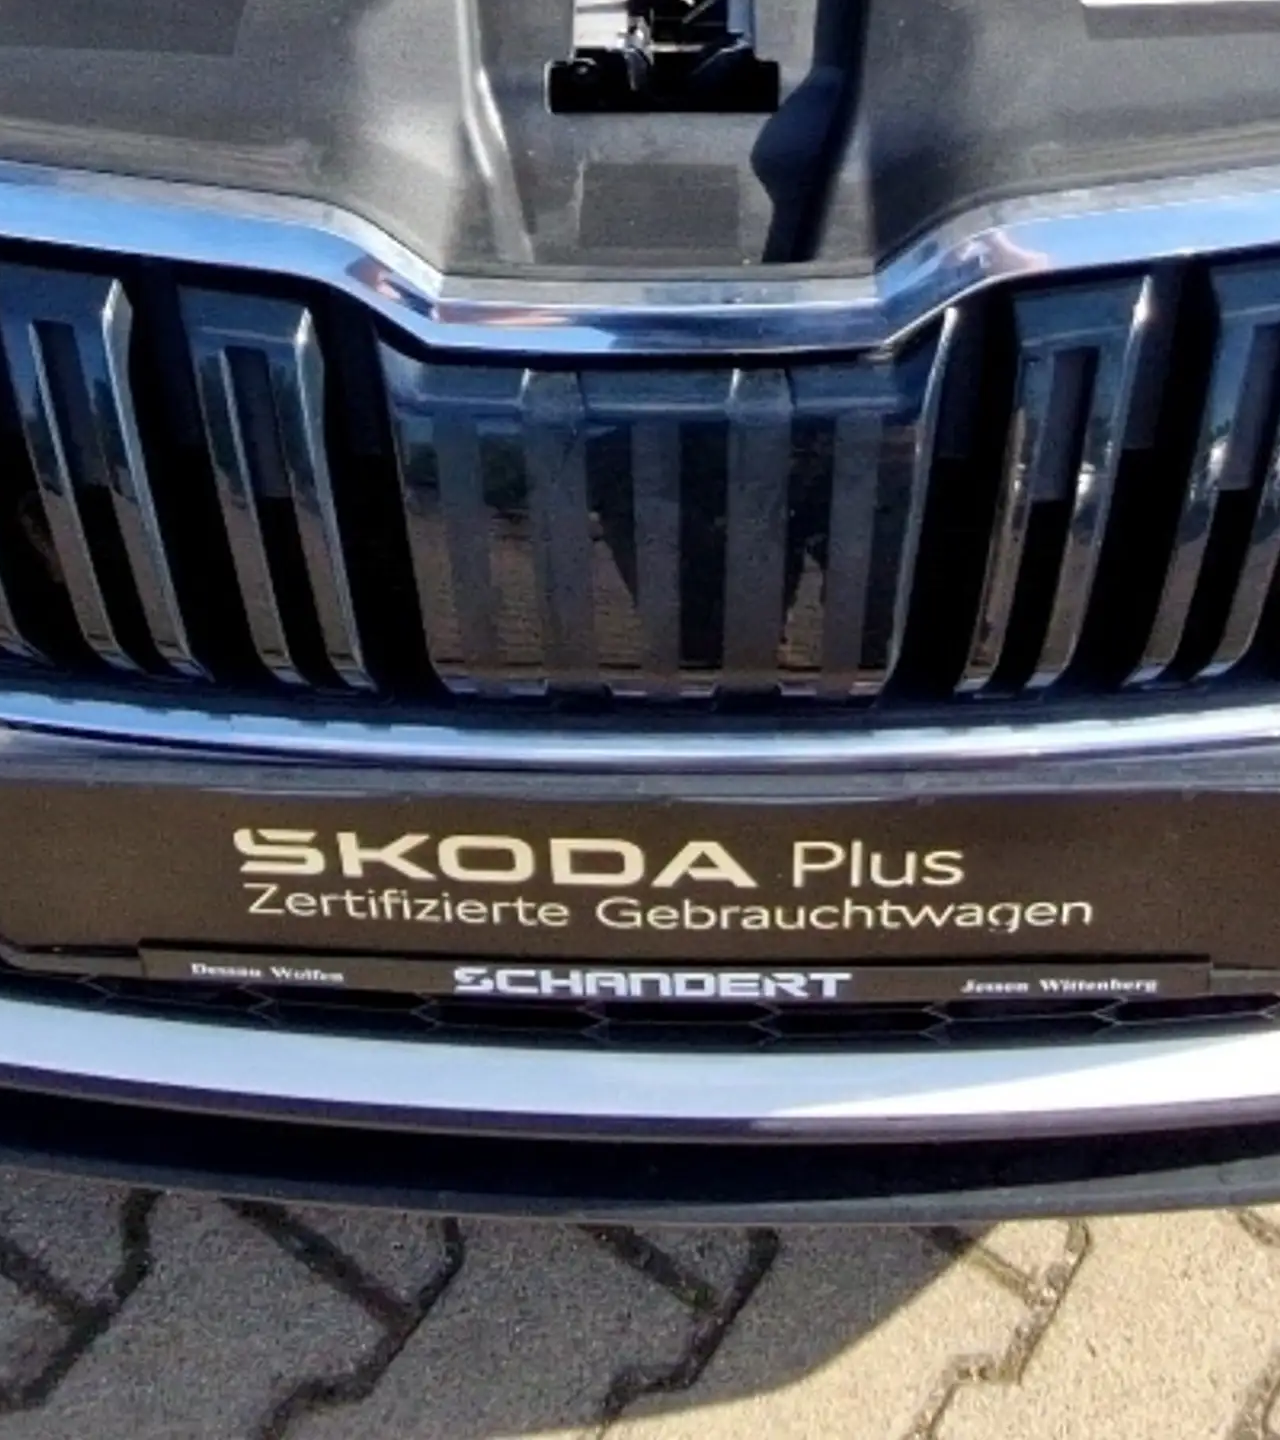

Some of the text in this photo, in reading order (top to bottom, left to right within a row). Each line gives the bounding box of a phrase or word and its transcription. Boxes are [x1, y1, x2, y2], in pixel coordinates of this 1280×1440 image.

[792, 839, 965, 889] Plus
[242, 883, 1094, 934] Zertifizierte Gebrauchtwagen
[453, 966, 853, 998] SCHANDERT
